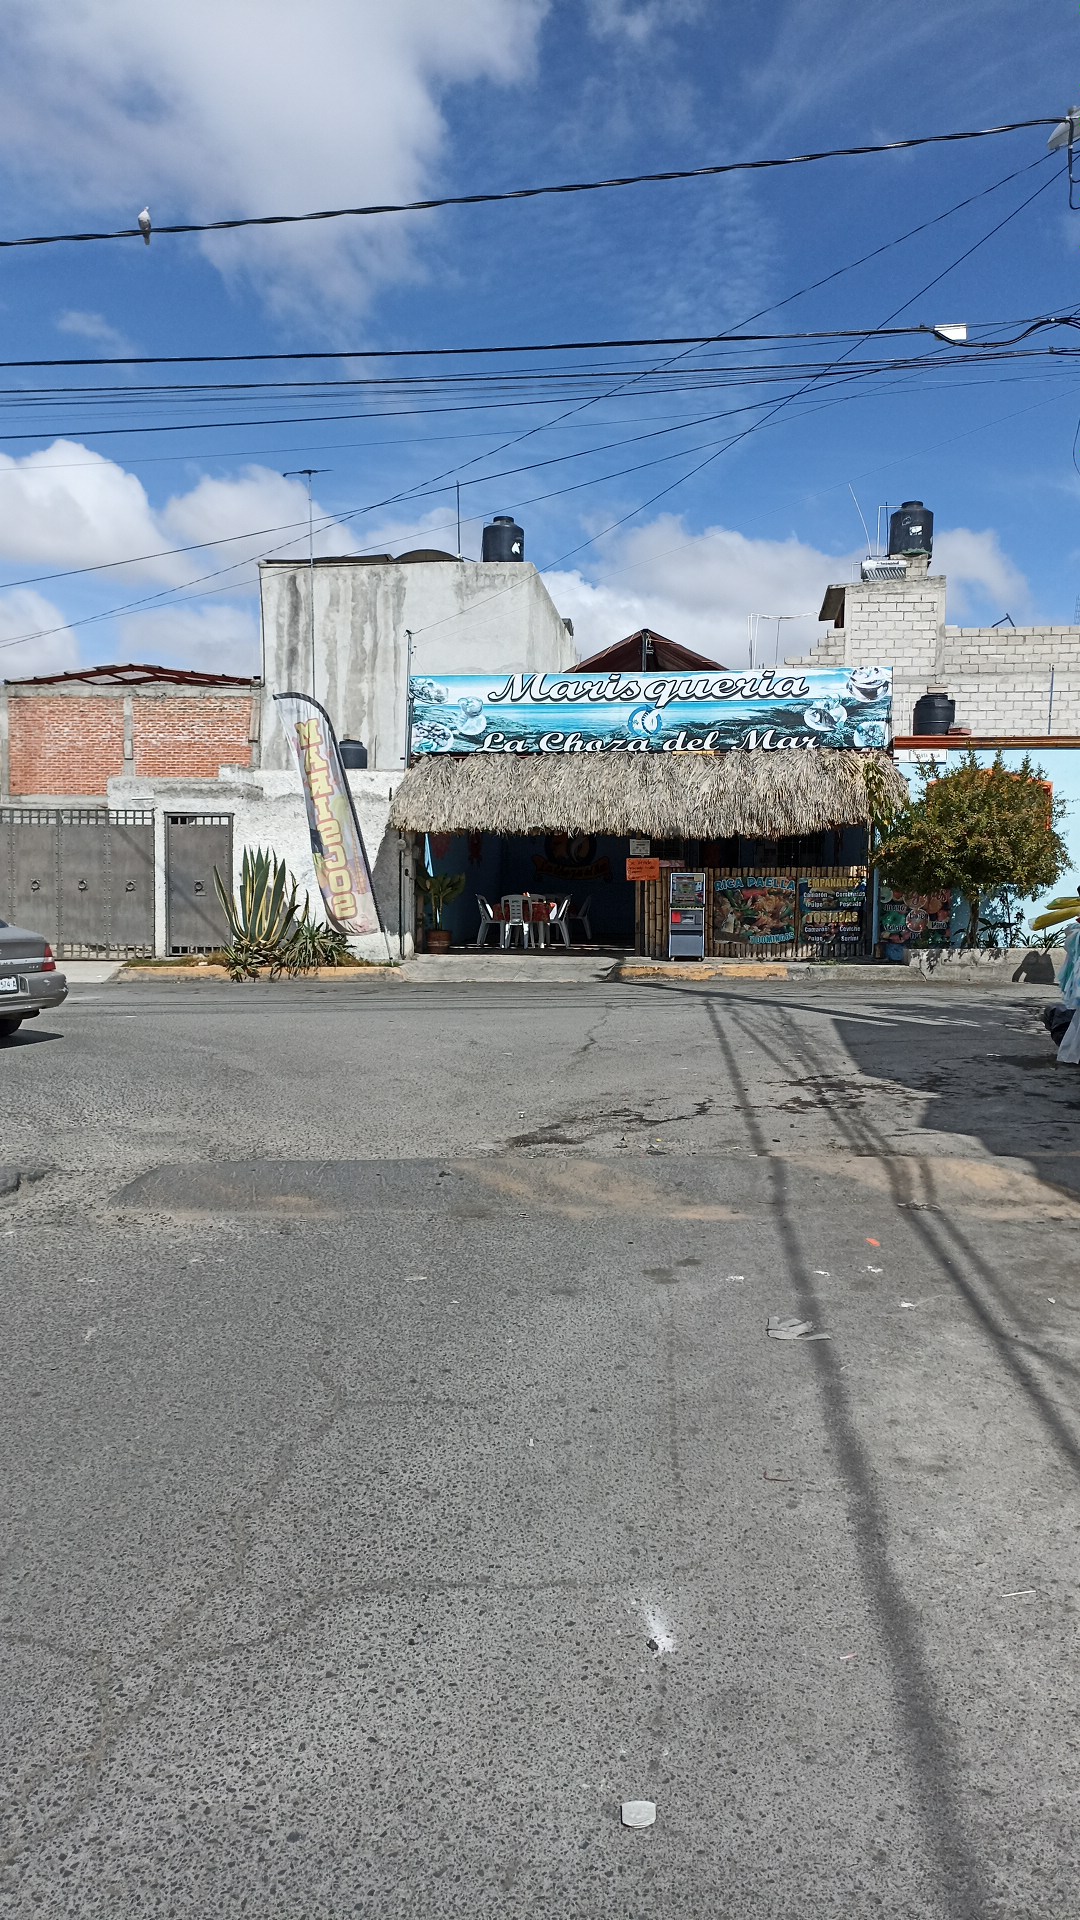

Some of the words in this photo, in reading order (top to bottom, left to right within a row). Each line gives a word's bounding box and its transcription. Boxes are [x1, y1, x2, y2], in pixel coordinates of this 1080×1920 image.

[475, 732, 528, 753] La
[539, 732, 654, 753] Choza
[662, 730, 720, 751] del
[732, 729, 820, 750] Mar
[714, 877, 744, 891] RICA
[746, 876, 796, 894] PAELLA
[808, 911, 859, 924] TOSTADAS
